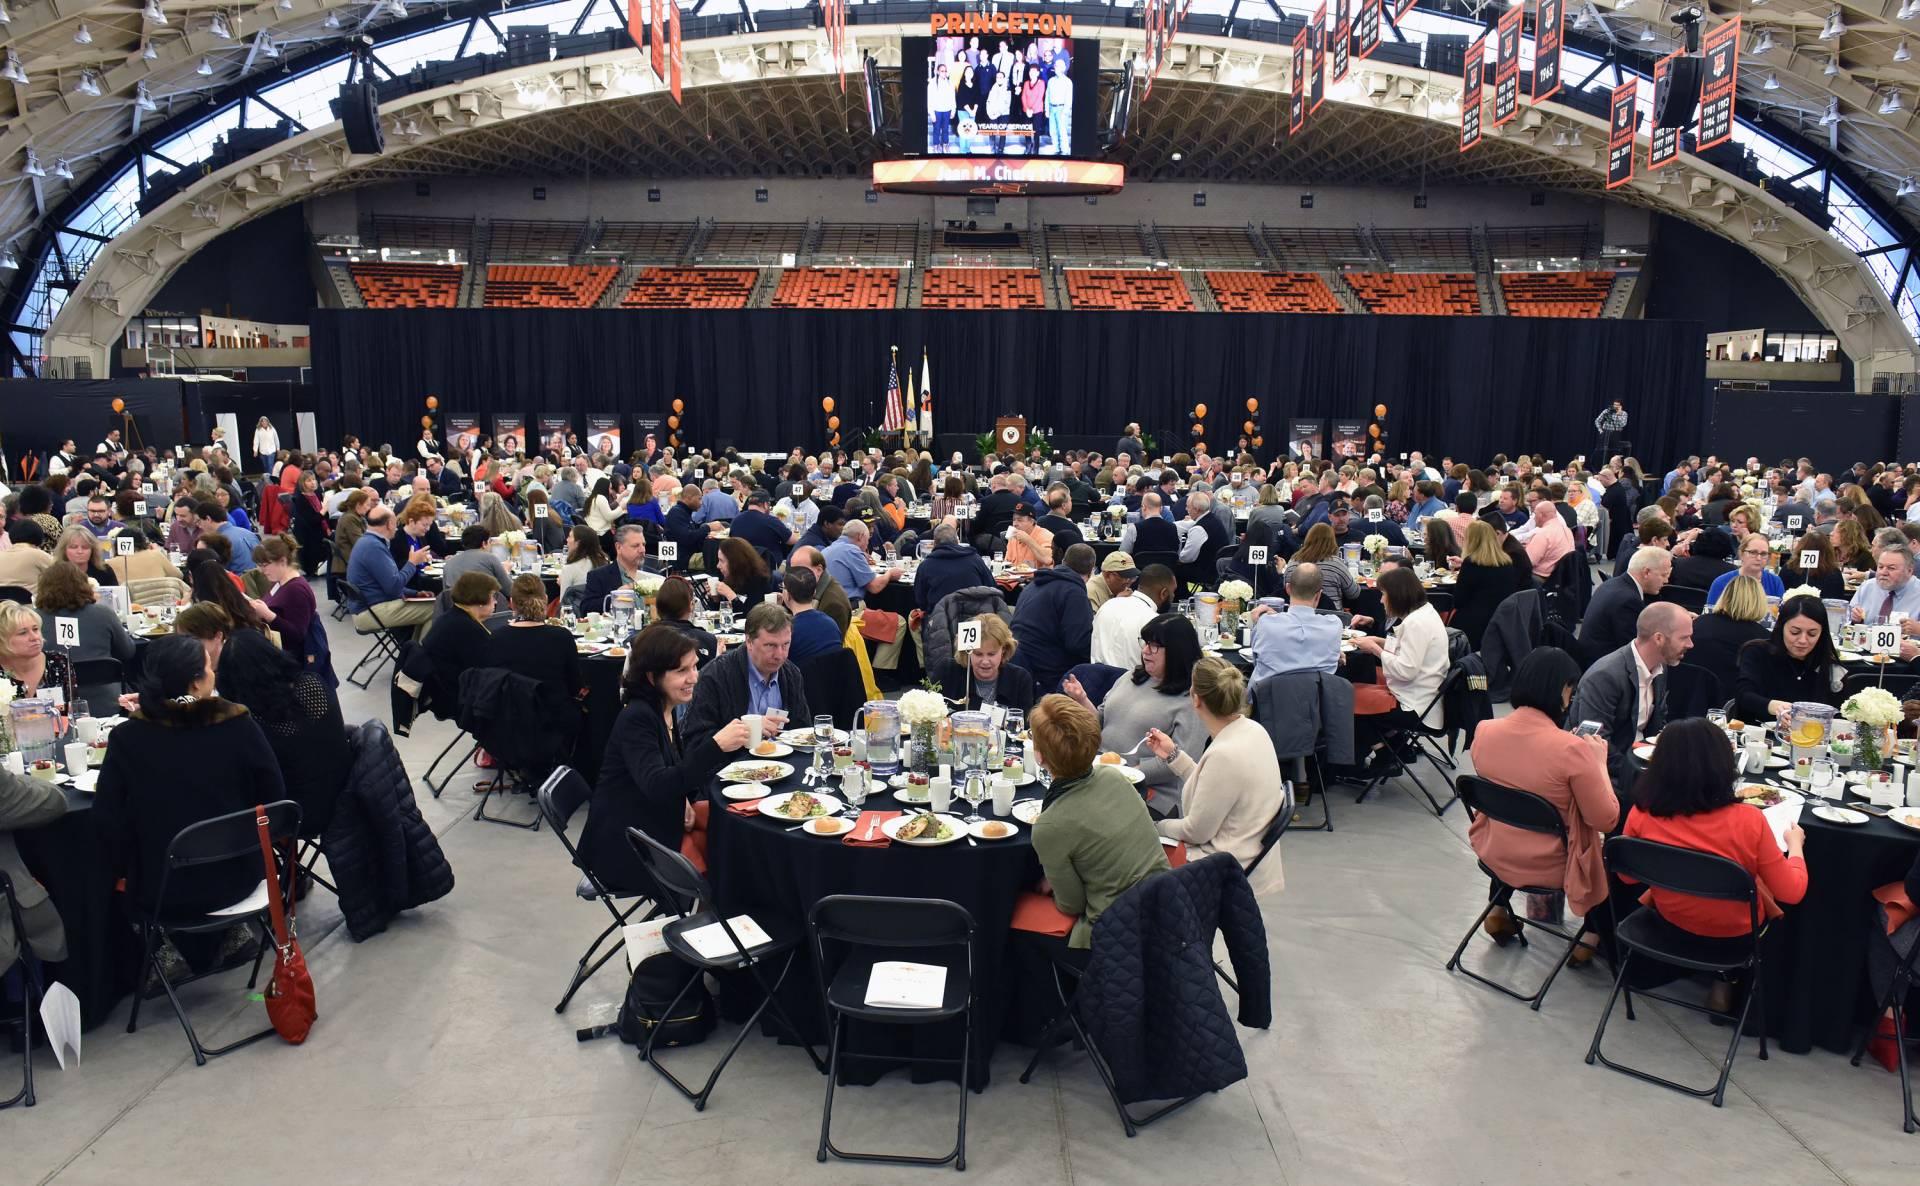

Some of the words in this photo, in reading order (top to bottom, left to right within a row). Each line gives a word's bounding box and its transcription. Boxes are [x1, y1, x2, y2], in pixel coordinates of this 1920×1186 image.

[930, 12, 1073, 36] PRINCETON
[1707, 28, 1736, 50] PRINCETON
[1540, 62, 1554, 82] 1965
[974, 165, 991, 181] M.
[477, 482, 484, 490] 46
[794, 486, 802, 494] 47
[136, 504, 145, 512] 56
[537, 507, 546, 515] 57
[956, 507, 966, 515] 58
[1370, 511, 1381, 519] 59
[120, 541, 132, 551] 67
[661, 546, 674, 556] 68
[1252, 550, 1264, 560] 69
[1804, 554, 1816, 564] 70
[60, 623, 74, 639] 78
[963, 627, 976, 643] 79
[1877, 631, 1895, 647] 80
